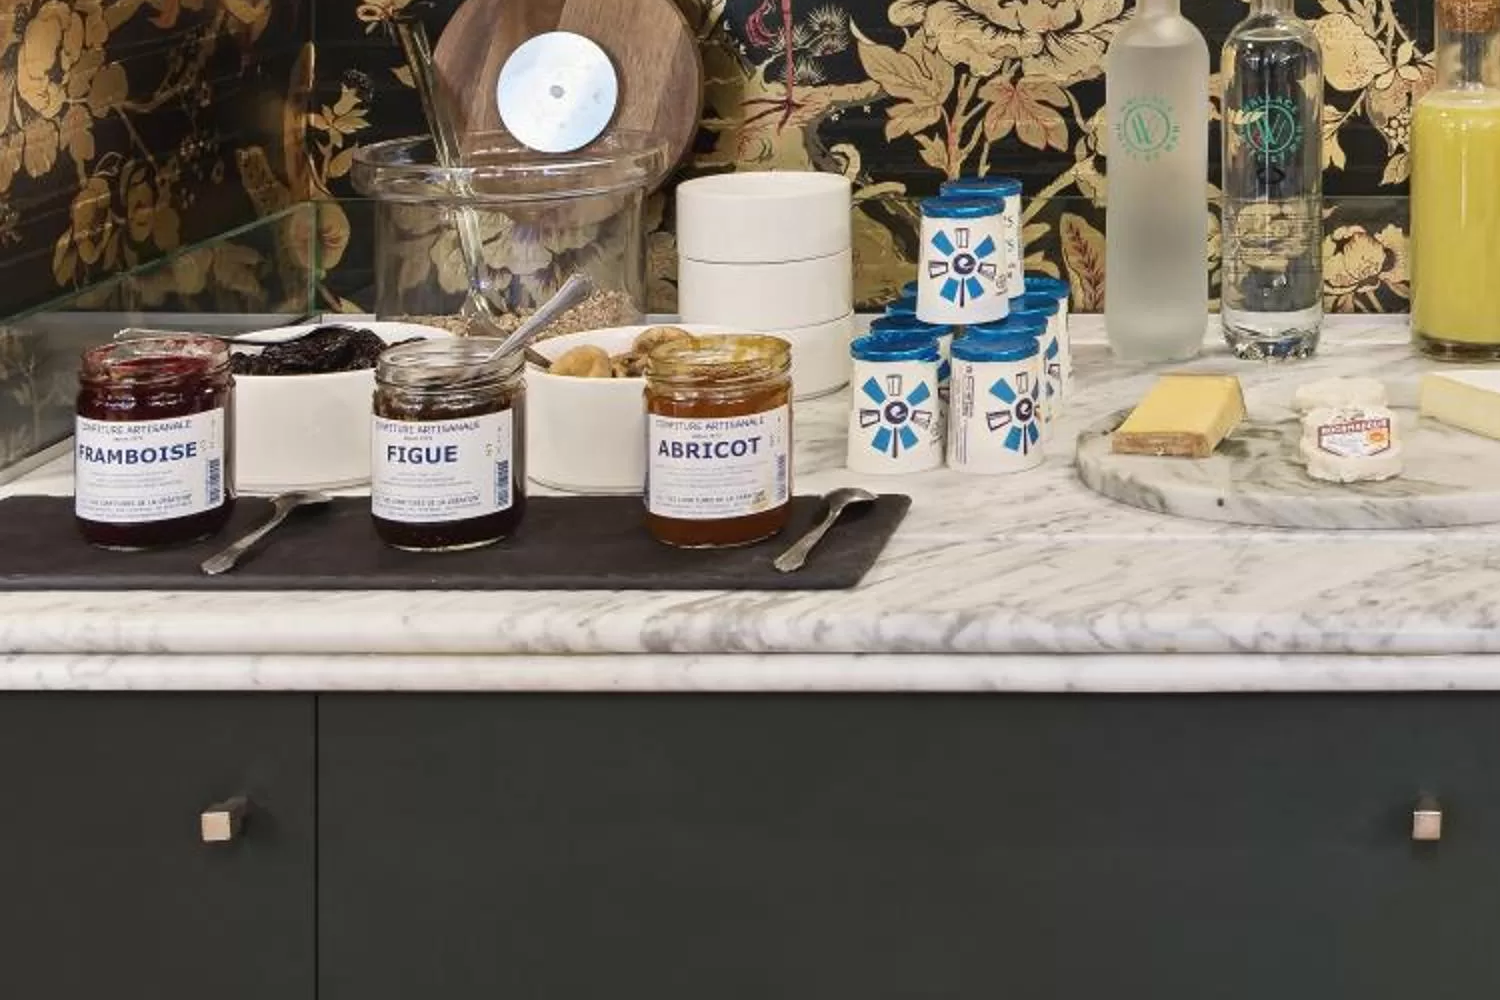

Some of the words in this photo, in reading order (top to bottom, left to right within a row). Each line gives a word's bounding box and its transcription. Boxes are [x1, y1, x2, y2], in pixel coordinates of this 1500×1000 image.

[127, 420, 192, 434] ARTISANALE
[375, 421, 415, 435] NFITURE
[417, 420, 480, 433] ARTISANALE
[705, 416, 764, 431] ARTISANALE
[79, 441, 197, 465] FRAMBOISE
[387, 445, 458, 464] FIGUE
[658, 436, 762, 459] ABRICOT
